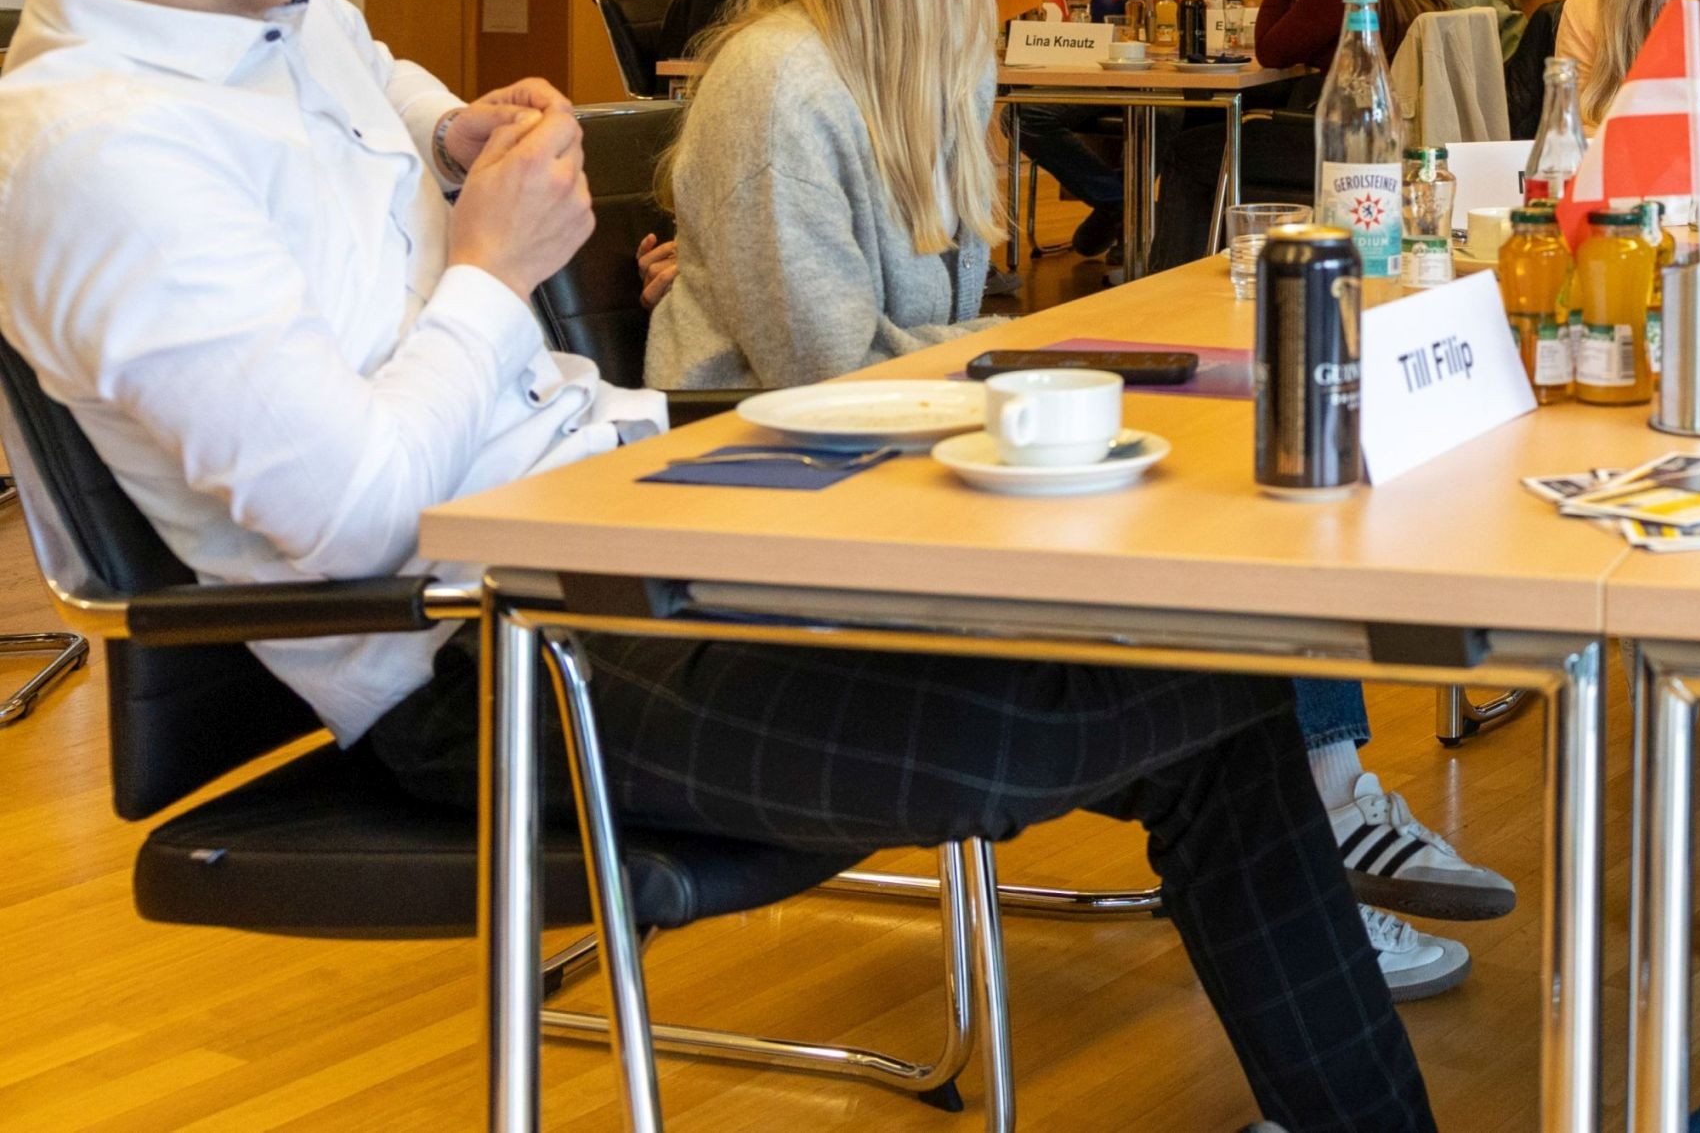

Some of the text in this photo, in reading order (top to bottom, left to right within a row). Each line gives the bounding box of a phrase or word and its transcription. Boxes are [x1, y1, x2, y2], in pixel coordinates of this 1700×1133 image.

[1025, 34, 1095, 49] Lina Knautz
[1398, 335, 1473, 393] Till Filip
